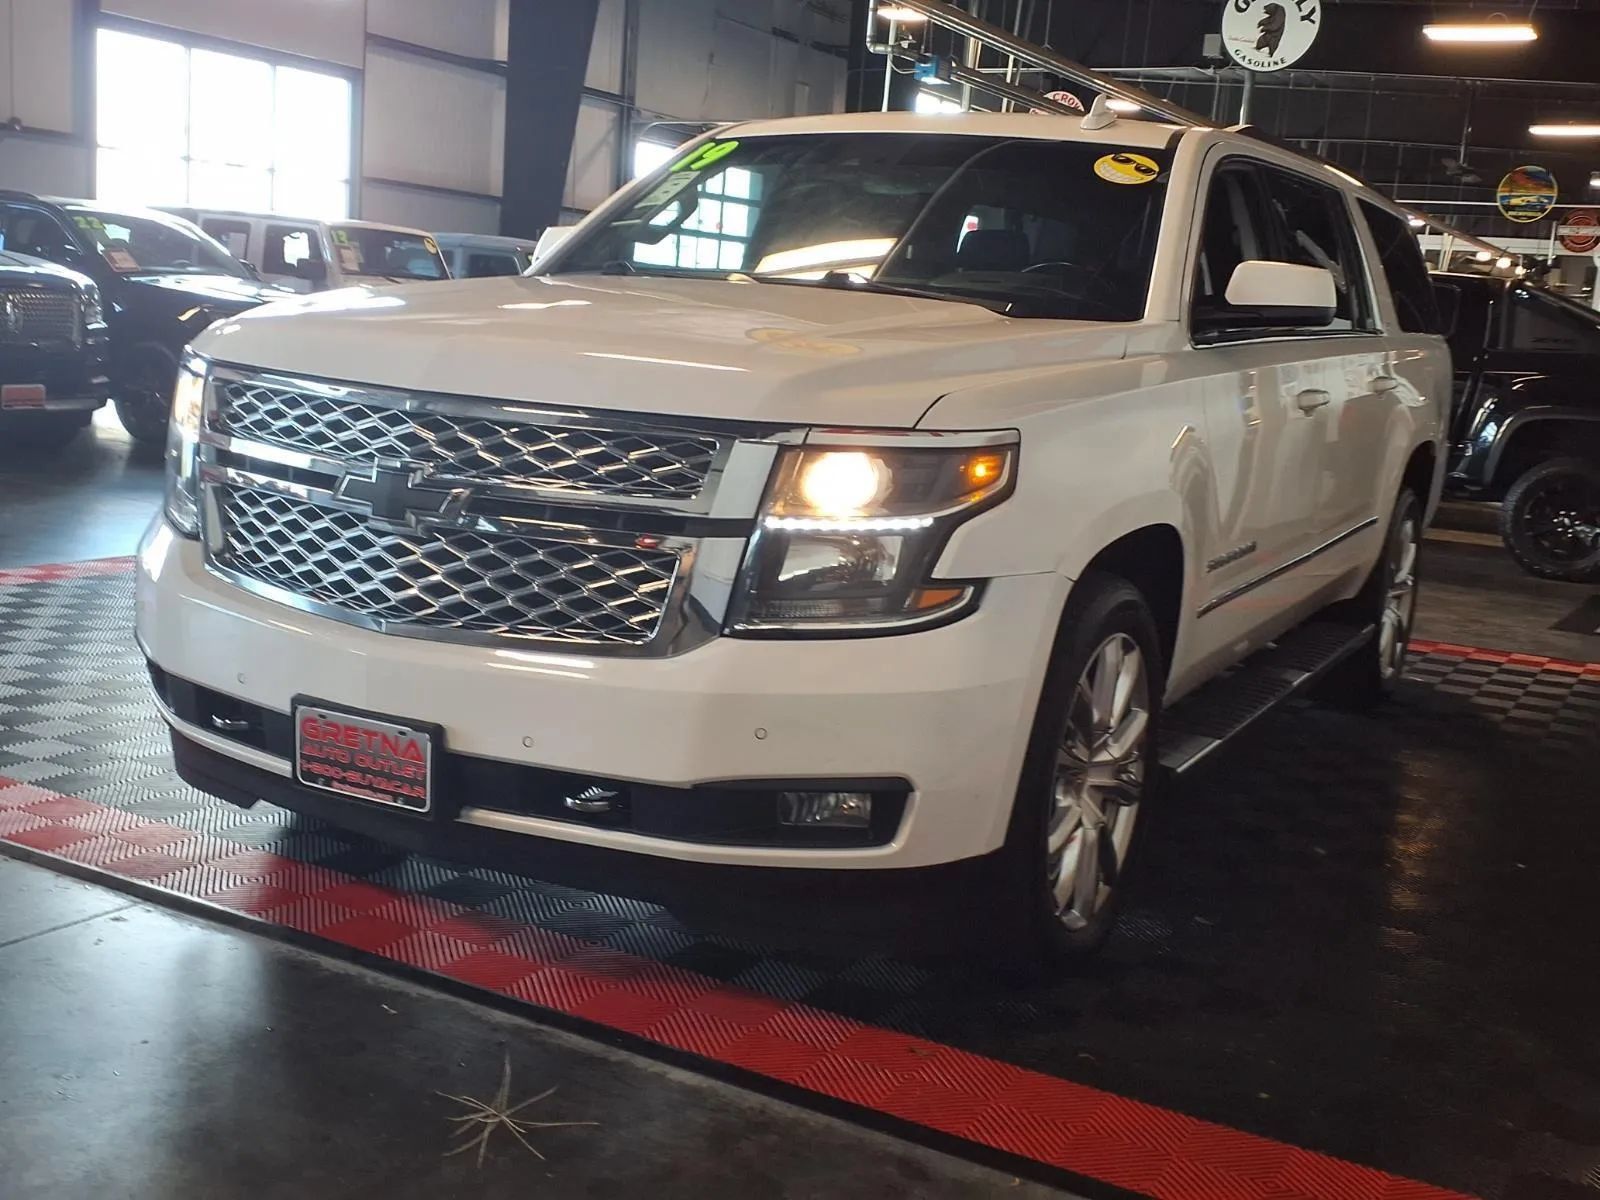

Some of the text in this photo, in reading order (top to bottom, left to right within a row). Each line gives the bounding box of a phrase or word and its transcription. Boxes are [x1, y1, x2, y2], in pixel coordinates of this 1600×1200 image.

[1234, 48, 1287, 68] GASOLINE
[670, 141, 739, 172] 19
[73, 216, 104, 229] 22
[301, 716, 424, 763] GRETNA
[301, 742, 426, 781] AUTO OUTLET
